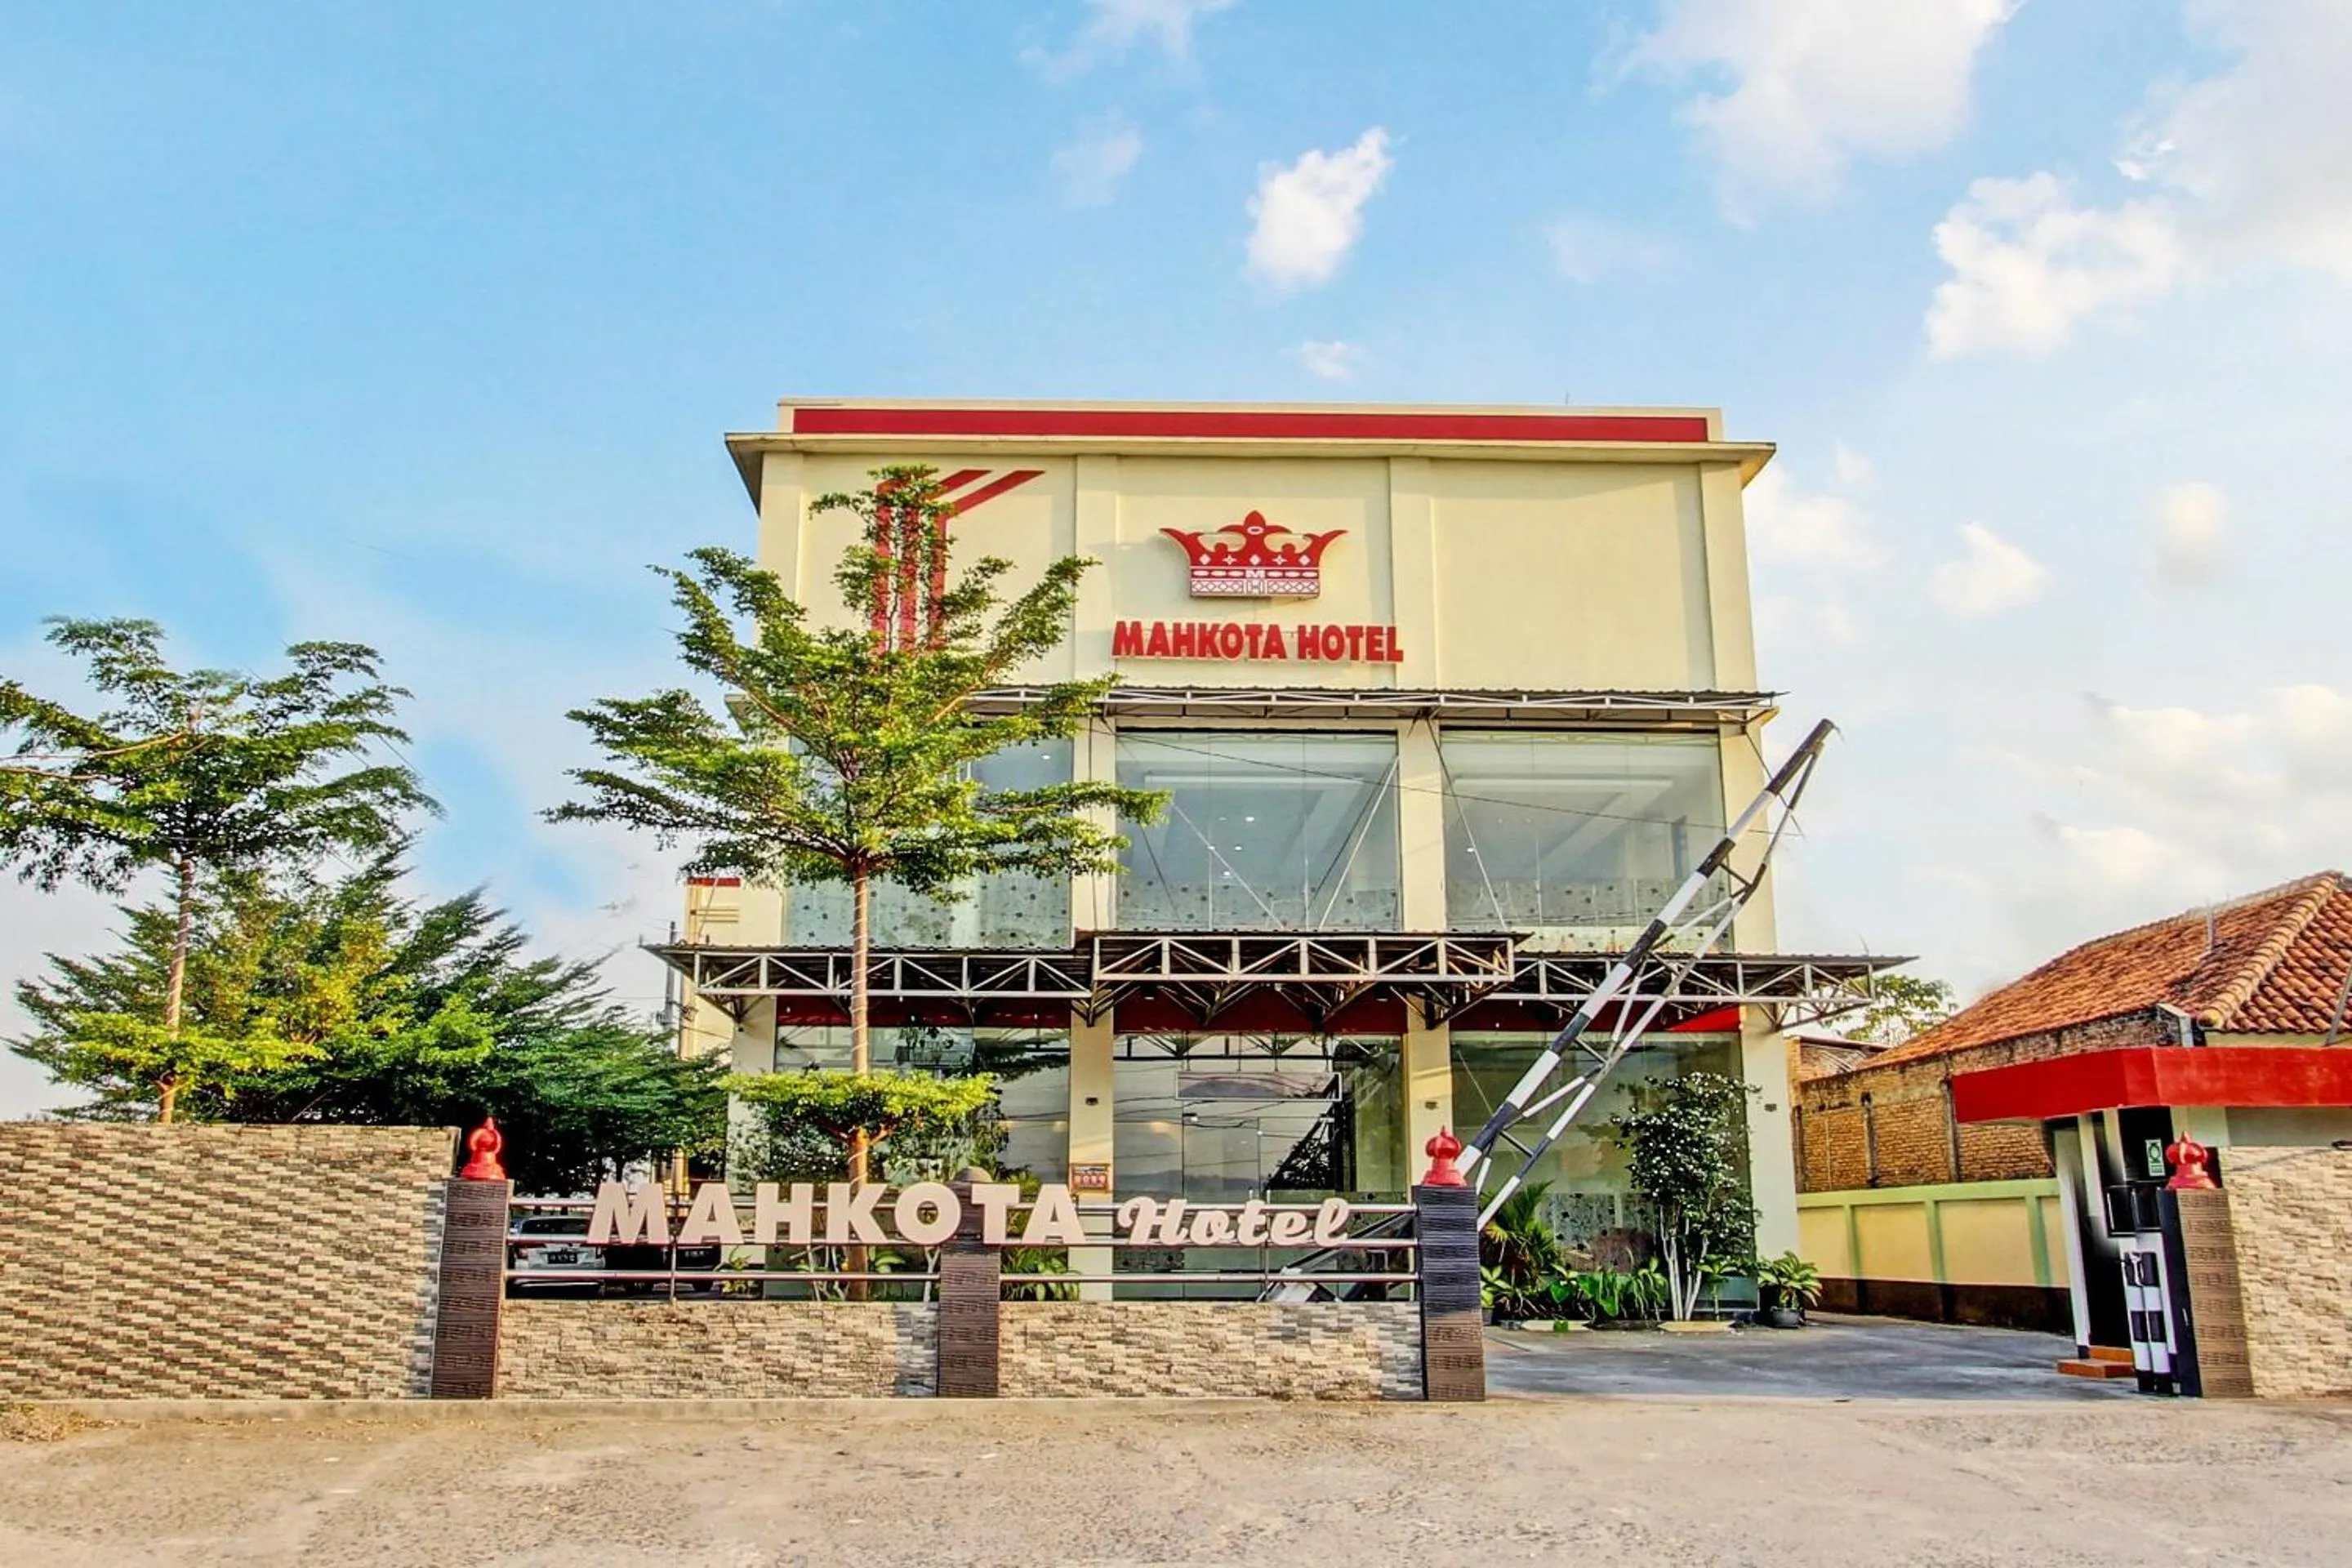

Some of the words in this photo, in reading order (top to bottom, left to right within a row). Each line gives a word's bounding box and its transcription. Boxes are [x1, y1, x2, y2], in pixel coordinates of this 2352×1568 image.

[1111, 620, 1287, 660] MAHKOTA
[1297, 624, 1405, 663] HOTEL
[586, 1181, 1086, 1246] MAHKOTA
[1116, 1196, 1353, 1247] Hotel
